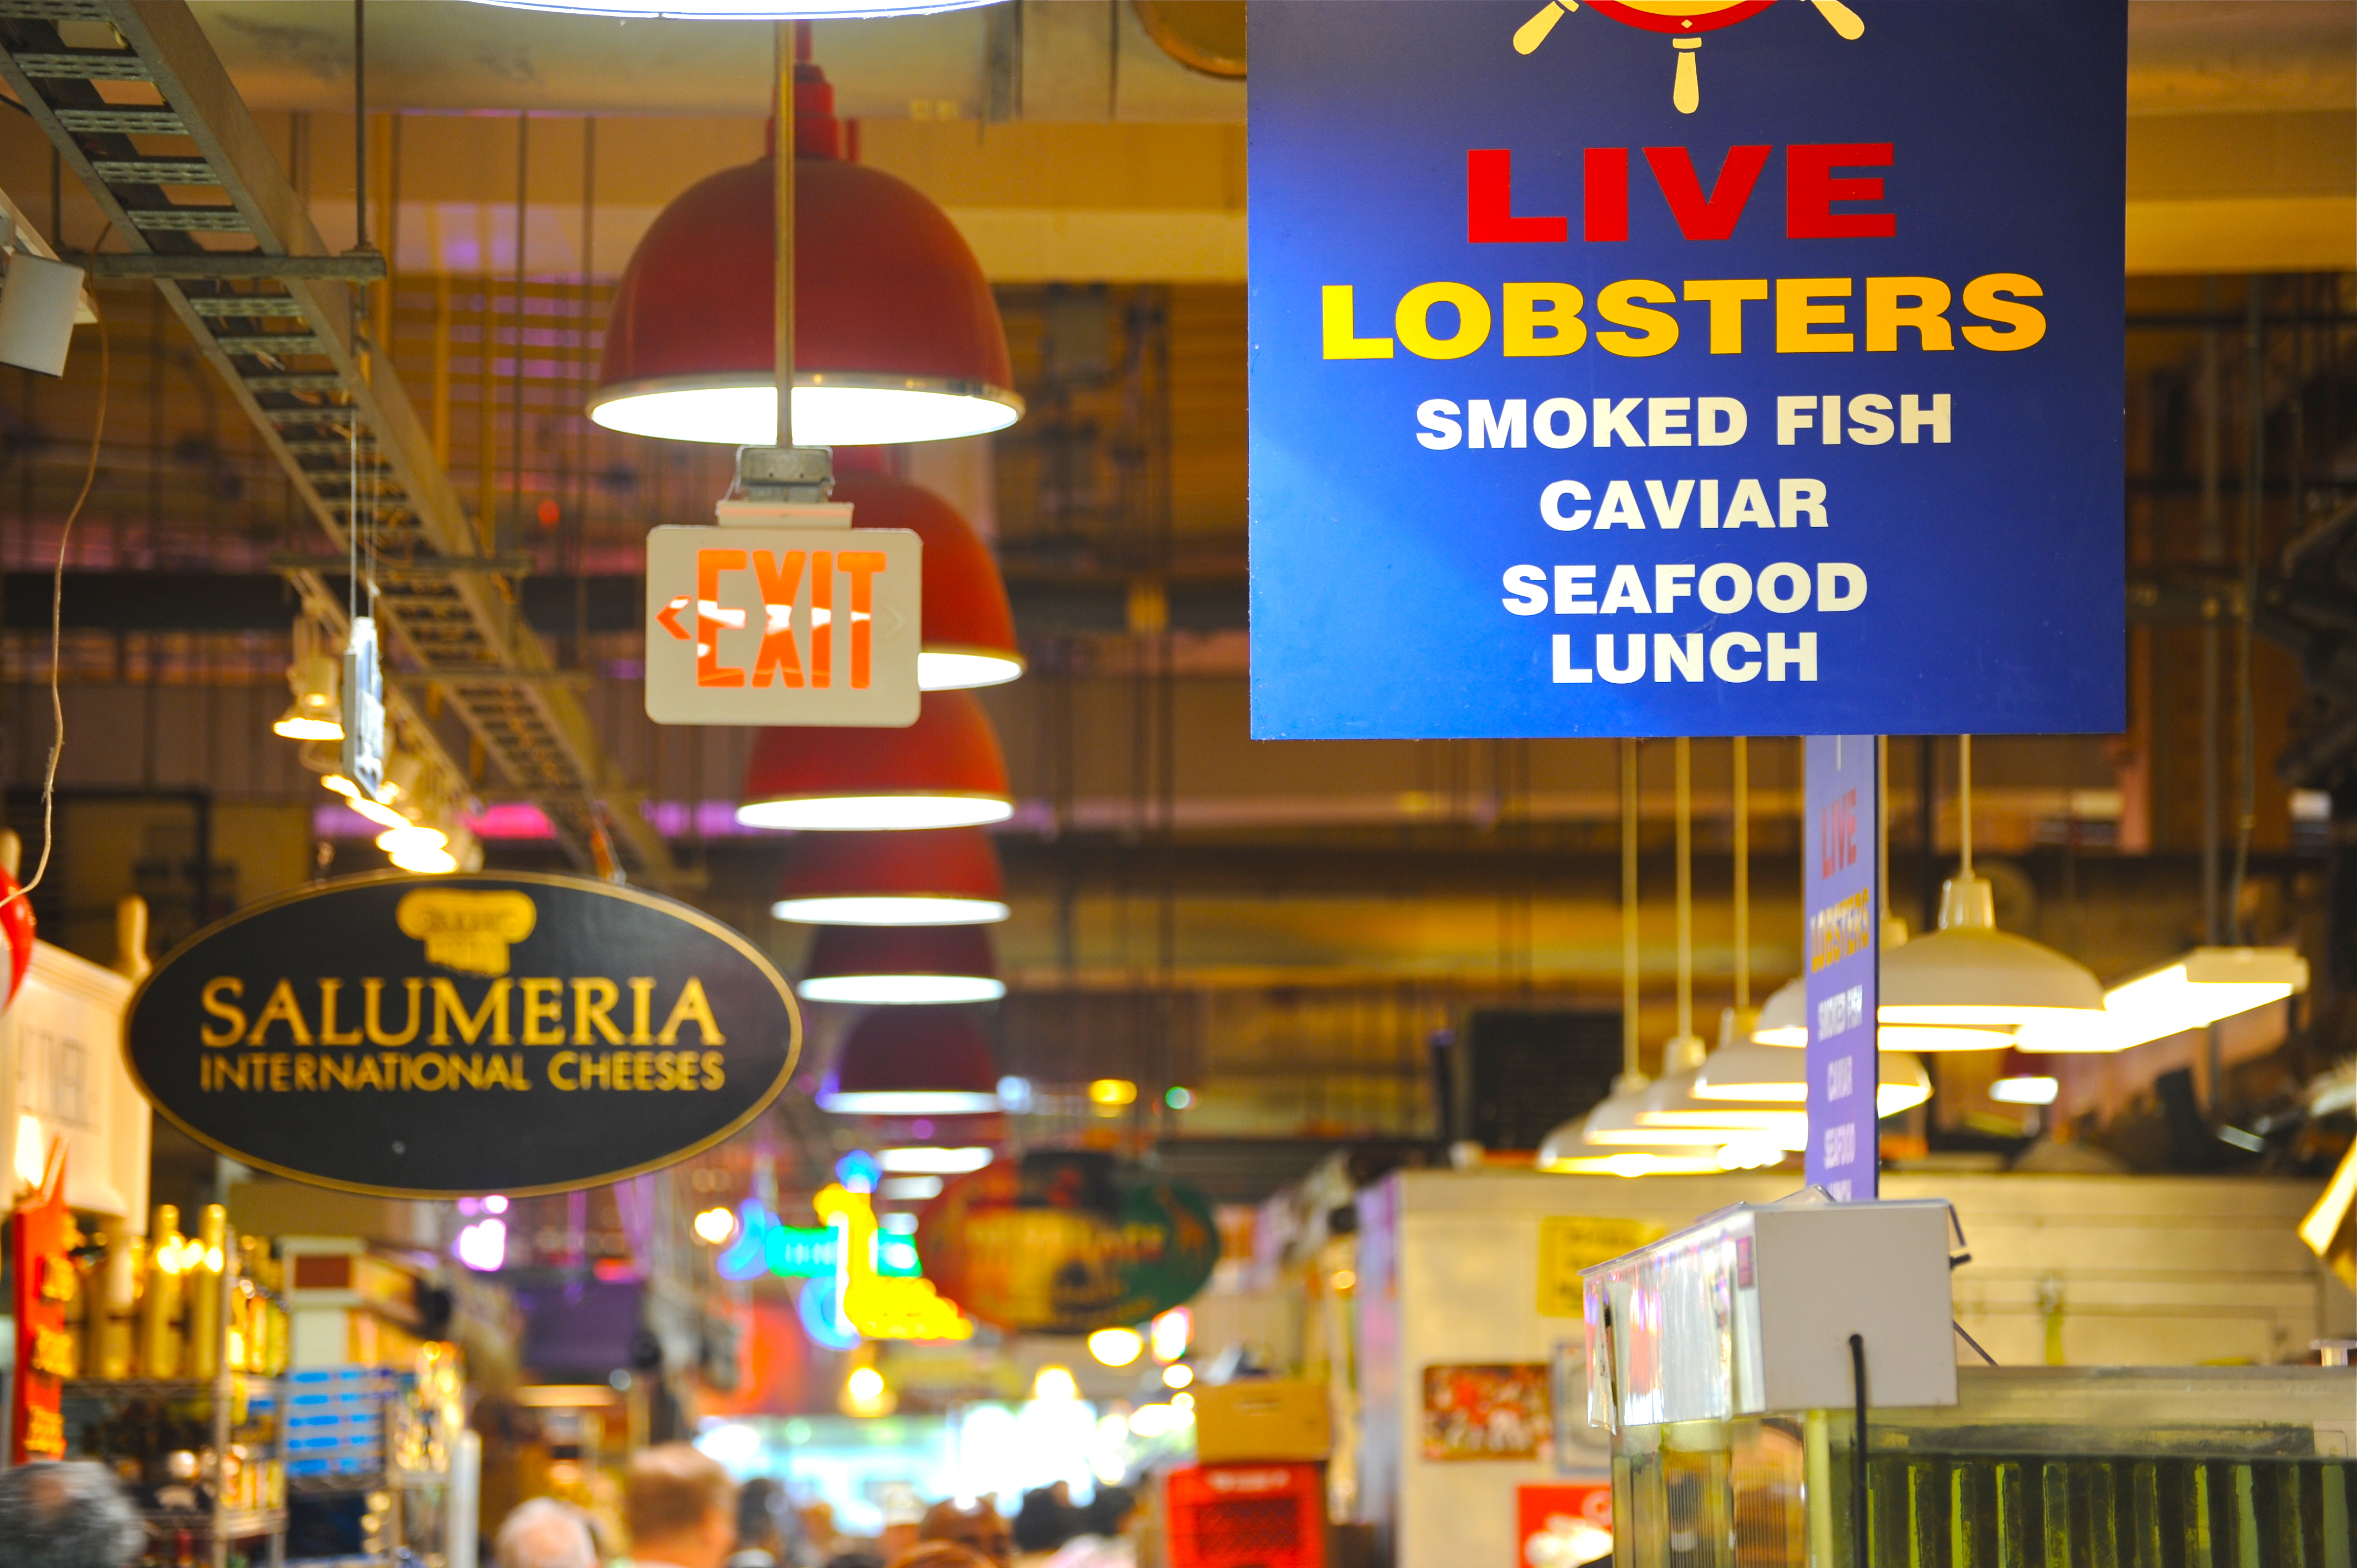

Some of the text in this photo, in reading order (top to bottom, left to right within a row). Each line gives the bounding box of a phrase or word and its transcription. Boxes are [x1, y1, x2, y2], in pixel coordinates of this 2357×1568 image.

[1468, 143, 1896, 243] LIVE
[1322, 272, 2047, 360] LOBSTERS
[1416, 394, 1951, 450] SMOKED FISH
[1540, 478, 1829, 532] CAVIAR
[696, 548, 887, 690] EXIT
[1501, 562, 1868, 616] SEAFOOD
[1552, 631, 1818, 684] LUNCH
[1821, 788, 1857, 880] LIVE
[1810, 887, 1869, 974] LOBSTERS
[200, 976, 727, 1048] SALUMERIA
[200, 1050, 727, 1091] INTERNATIONAL CHEESES
